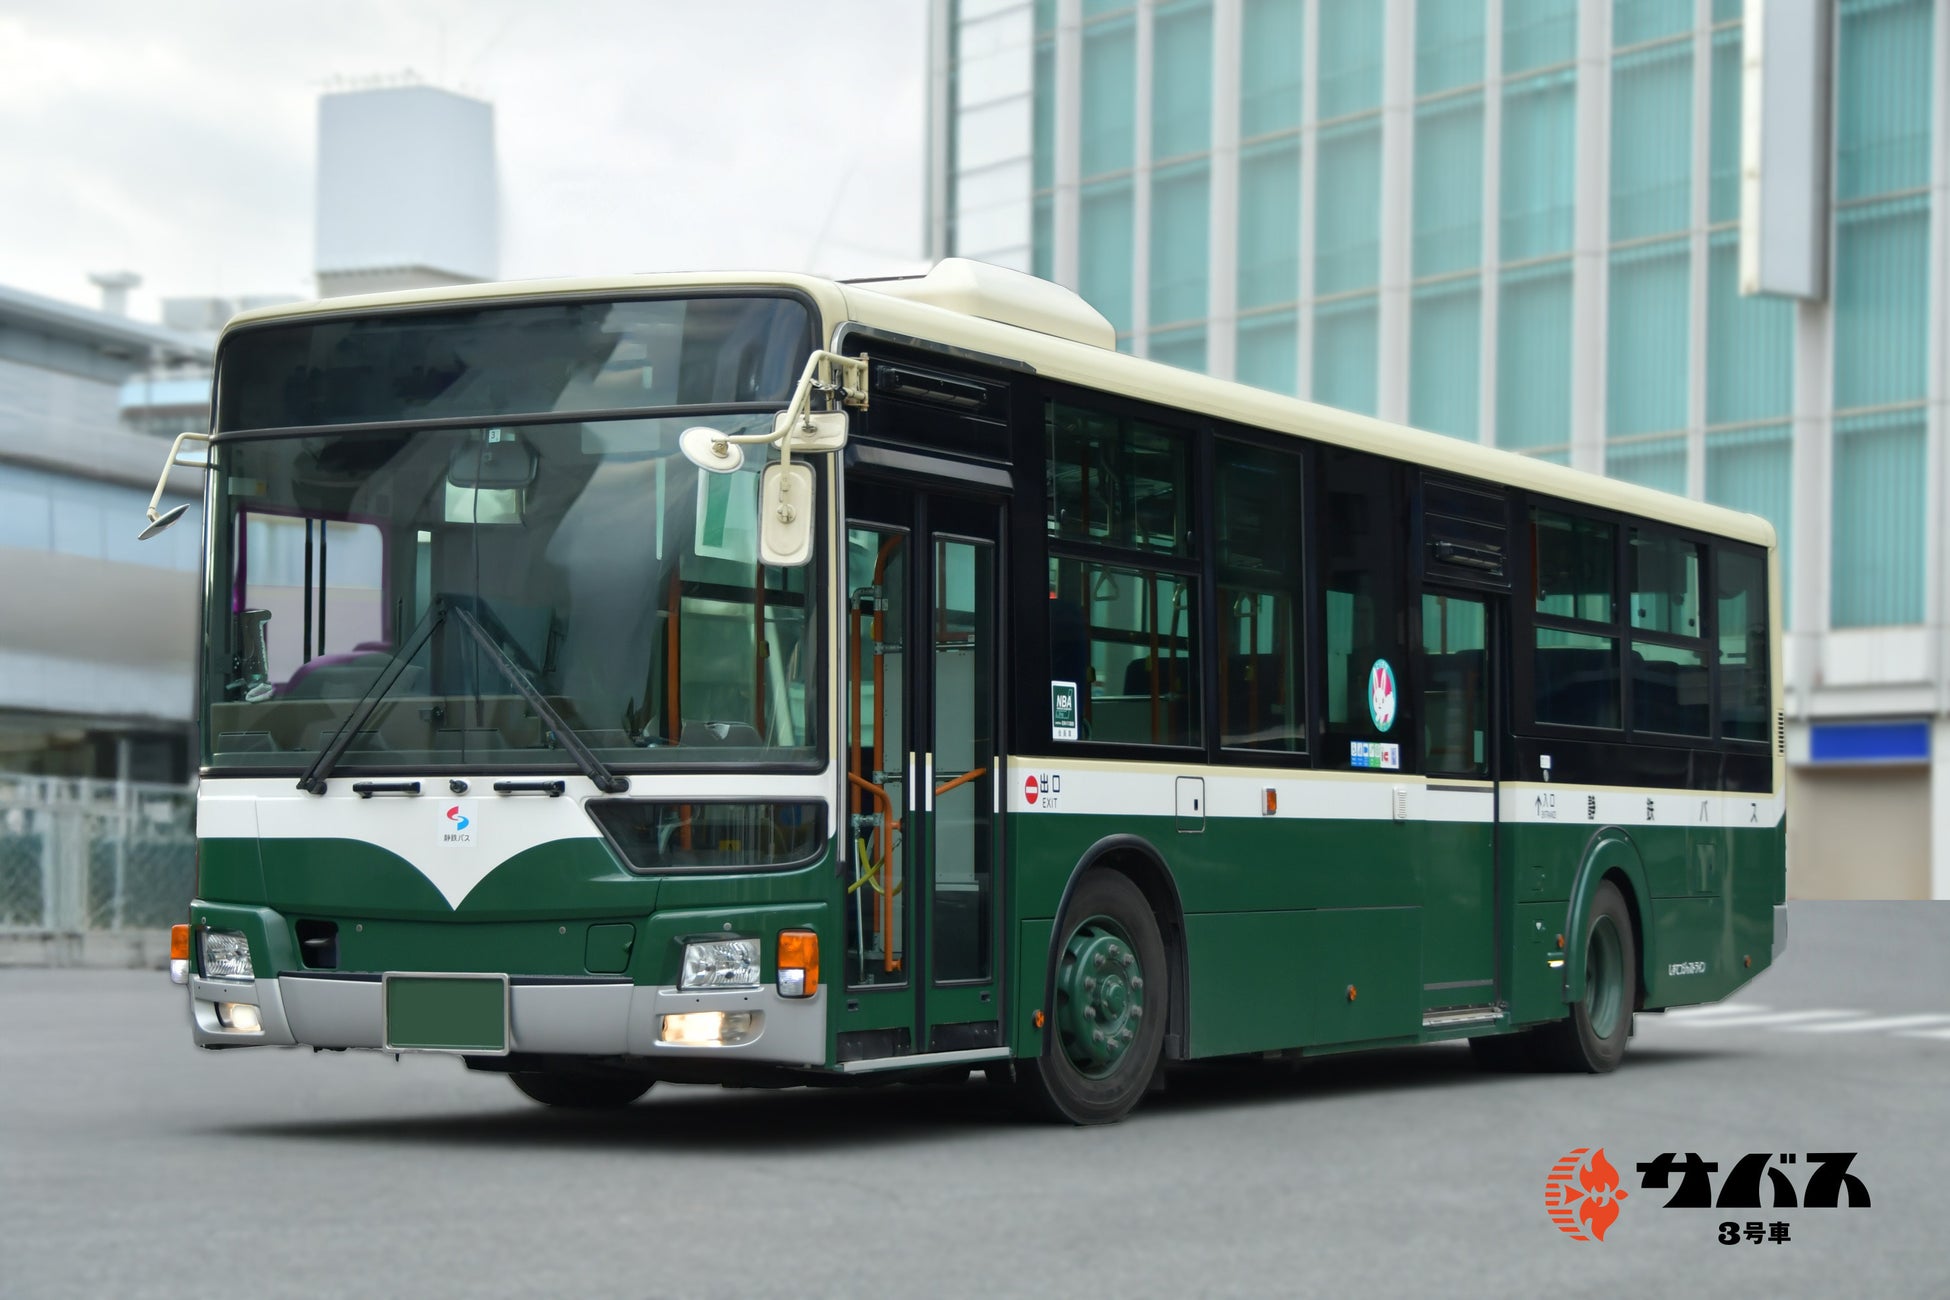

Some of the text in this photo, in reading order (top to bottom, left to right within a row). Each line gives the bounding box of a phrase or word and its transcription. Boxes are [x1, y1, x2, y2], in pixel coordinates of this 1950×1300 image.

[1056, 695, 1072, 708] NBA
[1040, 773, 1060, 794] 出口
[1042, 797, 1058, 808] EXIT
[1542, 793, 1555, 808] 入口
